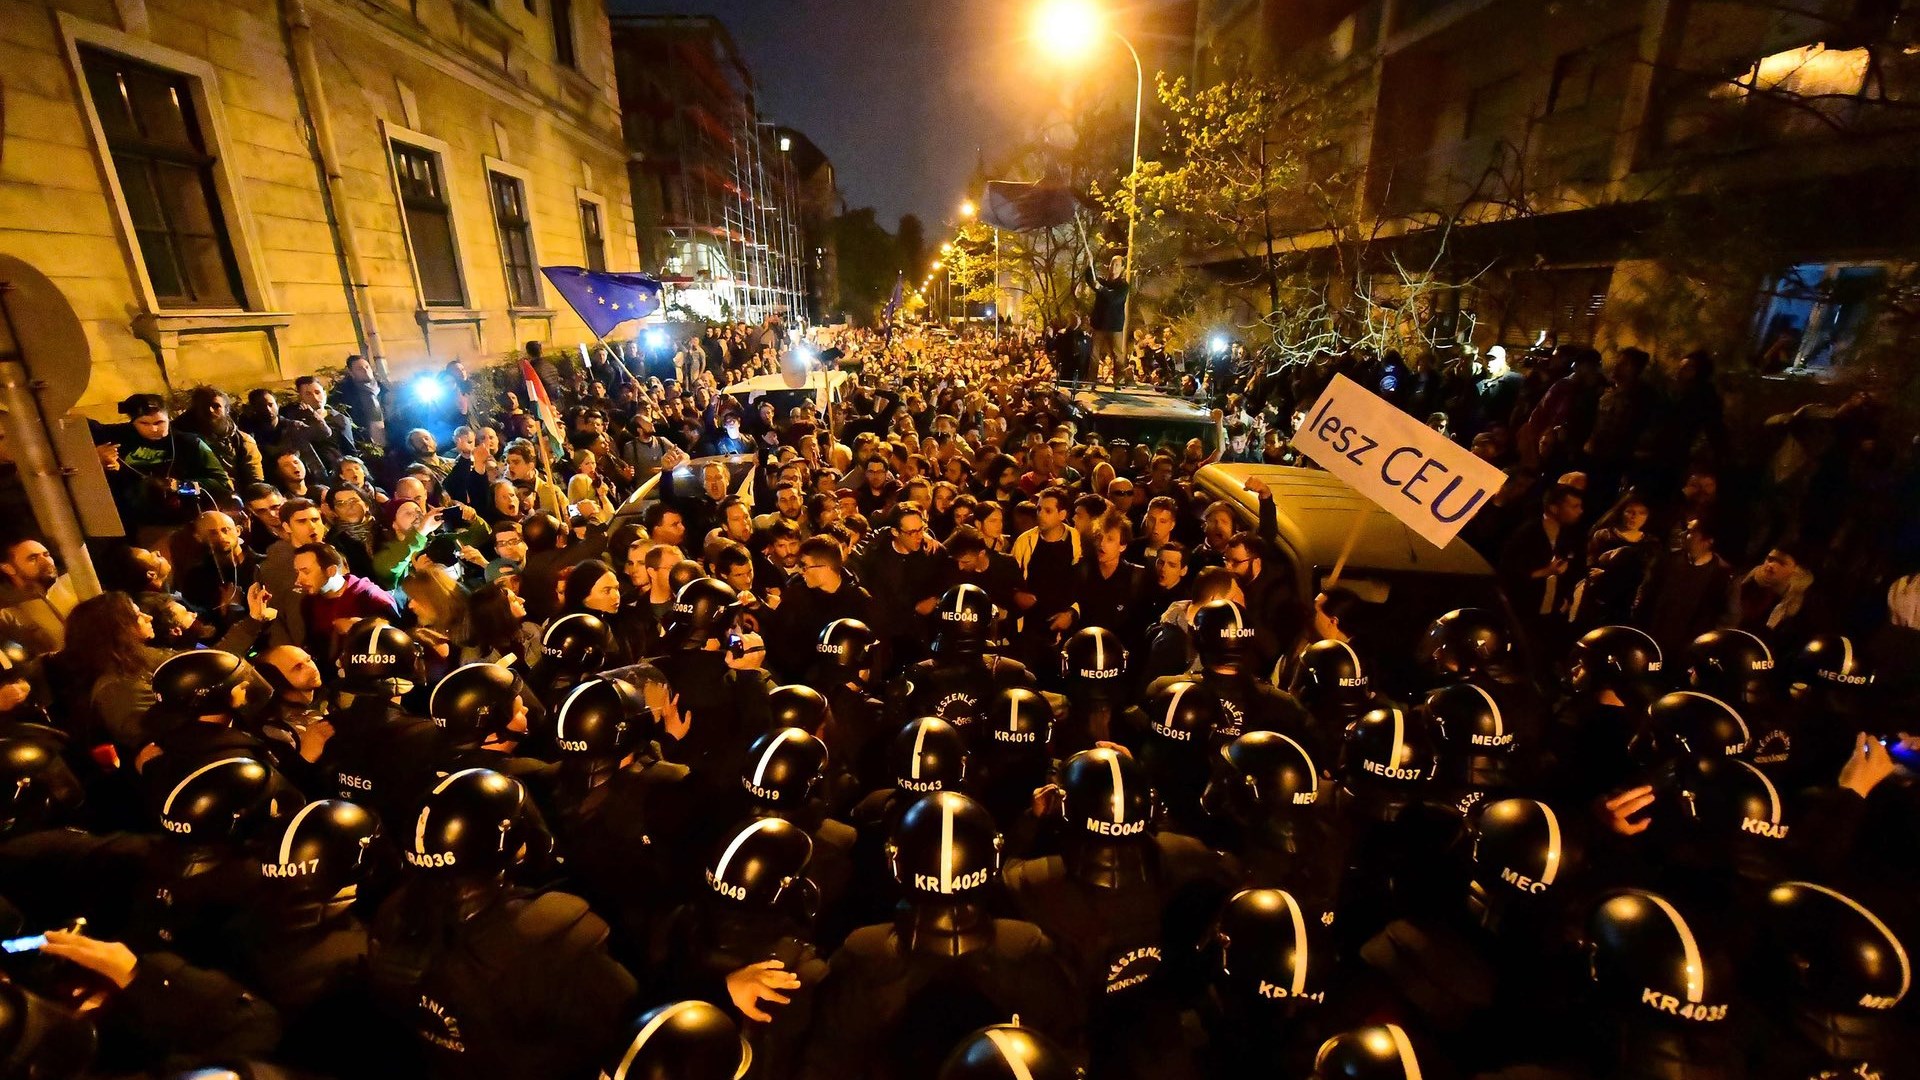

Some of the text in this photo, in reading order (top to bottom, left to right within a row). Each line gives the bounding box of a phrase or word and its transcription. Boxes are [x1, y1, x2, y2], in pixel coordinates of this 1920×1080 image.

[1308, 397, 1486, 523] lesz CEU
[351, 652, 396, 665] KR4038
[1080, 667, 1118, 680] MEO022
[994, 731, 1036, 744] KR4016
[1363, 758, 1422, 781] MEO037
[898, 777, 943, 793] KR4043
[160, 814, 192, 835] 4020
[1086, 817, 1145, 837] MEO042
[262, 858, 321, 879] KR4017
